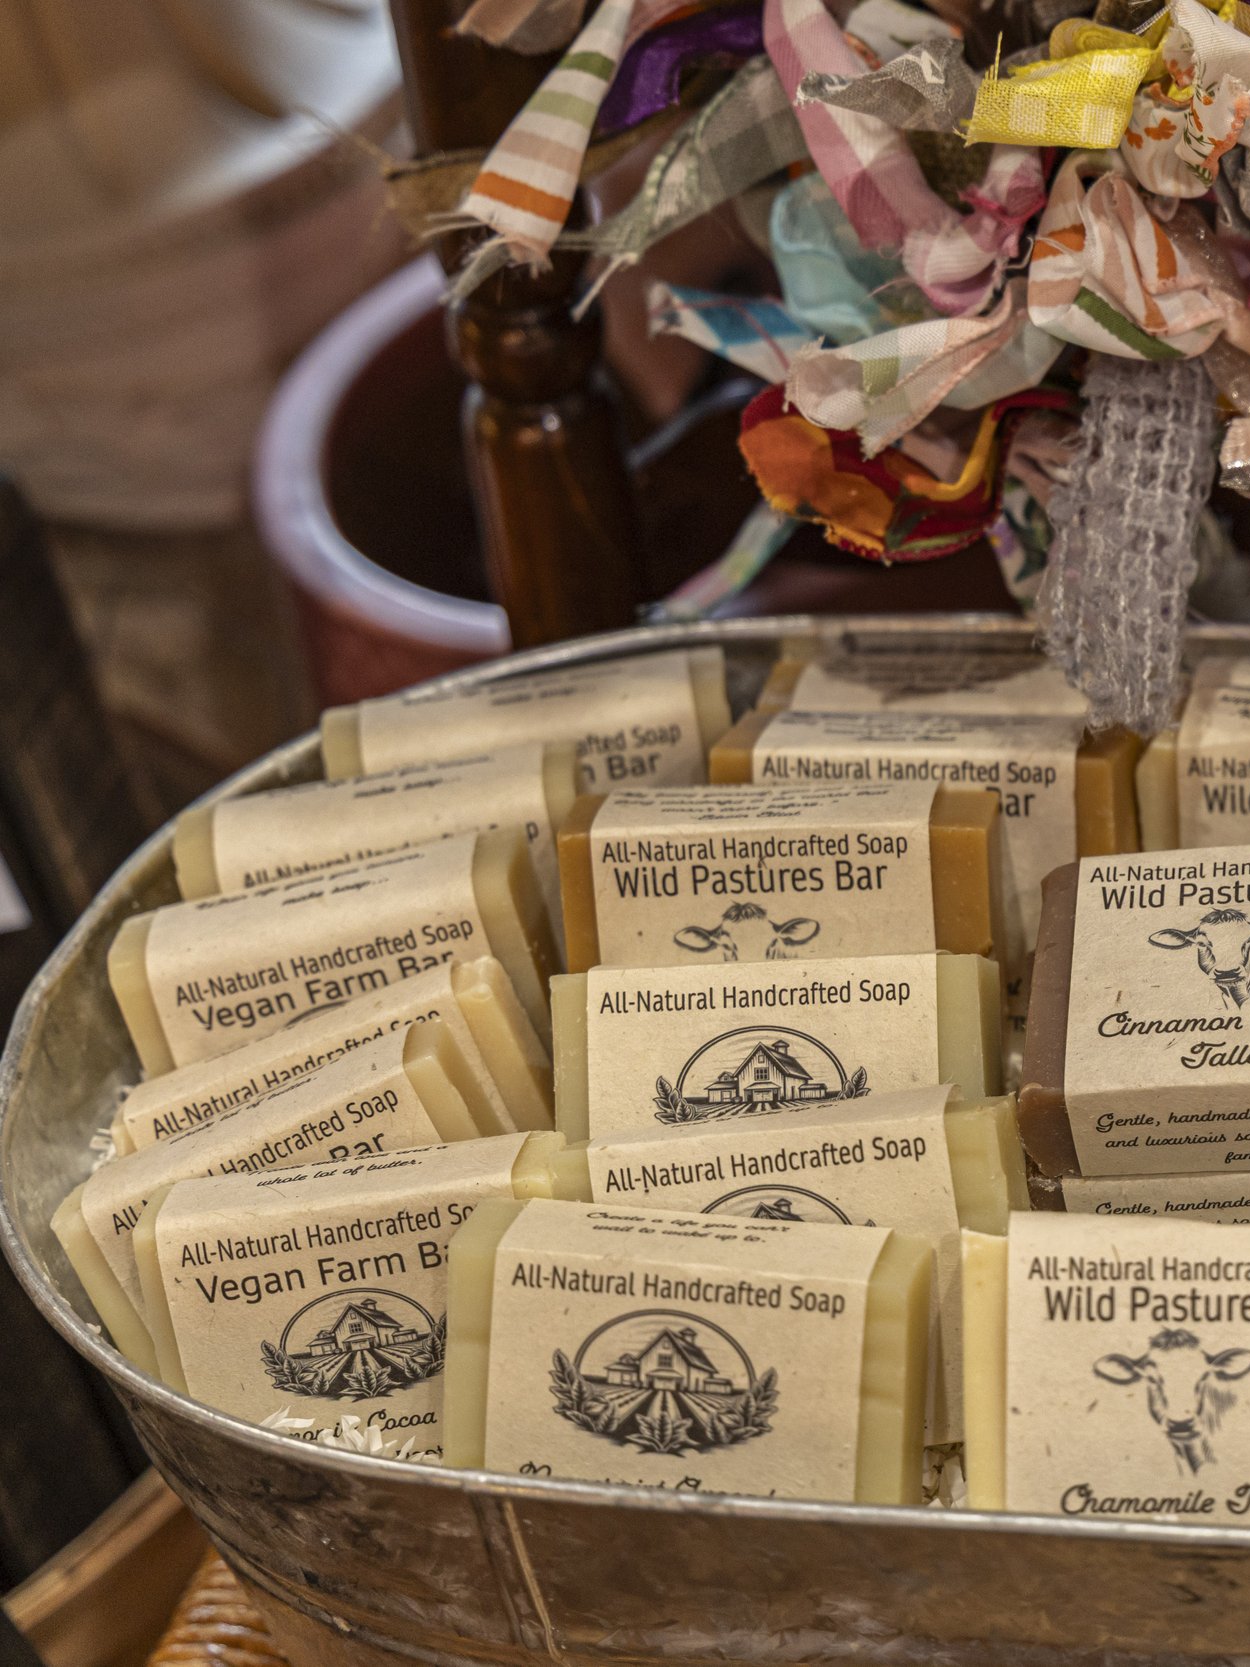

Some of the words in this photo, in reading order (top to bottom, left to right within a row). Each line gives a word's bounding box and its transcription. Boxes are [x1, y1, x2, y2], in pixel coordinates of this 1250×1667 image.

[607, 752, 660, 781] Bar
[762, 756, 871, 781] All-Natural
[878, 759, 1000, 784] Handcrafted
[1006, 762, 1057, 788] Soap
[602, 838, 717, 864] All-Natural
[722, 833, 850, 860] Handcrafted
[856, 832, 909, 859] Soap
[614, 864, 679, 899] Wild
[691, 862, 825, 896] Pastures
[835, 859, 889, 892] Bar
[1090, 861, 1205, 884] All-Natural
[1101, 883, 1166, 910] Wild
[175, 961, 288, 1007] All-Natural
[291, 930, 417, 979] Handcrafted
[422, 917, 474, 948] Soap
[192, 992, 297, 1032] Vegan
[305, 965, 389, 1005] Farm
[600, 986, 715, 1015] All-Natural
[723, 980, 852, 1010] Handcrafted
[859, 977, 911, 1006] Soap
[1097, 1009, 1244, 1039] Cinnamon
[153, 1079, 260, 1140] All-Natural
[1095, 1112, 1161, 1134] Gentle,
[220, 1110, 345, 1176] Handcrafted
[346, 1089, 399, 1126] Soap
[1105, 1135, 1139, 1149] and
[1145, 1132, 1228, 1148] luxurious
[257, 1173, 308, 1187] whole
[314, 1169, 337, 1179] lot
[343, 1164, 364, 1176] of
[367, 1158, 422, 1172] butter.
[605, 1155, 725, 1194] All-Natural
[730, 1139, 865, 1179] Handcrafted
[872, 1136, 928, 1162] Soap
[1095, 1201, 1158, 1216] Gentle,
[181, 1227, 302, 1268] All-Natural
[305, 1200, 442, 1250] Handcrafted
[703, 1222, 738, 1231] you
[196, 1267, 306, 1304] Vegan
[319, 1249, 407, 1286] Farm
[1028, 1256, 1154, 1283] All-Natural
[512, 1263, 635, 1298] All-Natural
[644, 1273, 782, 1310] Handcrafted
[788, 1285, 846, 1320] Soap
[1044, 1286, 1116, 1322] Wild
[367, 1408, 438, 1433] Cocoa
[1060, 1482, 1216, 1515] Chamomile
